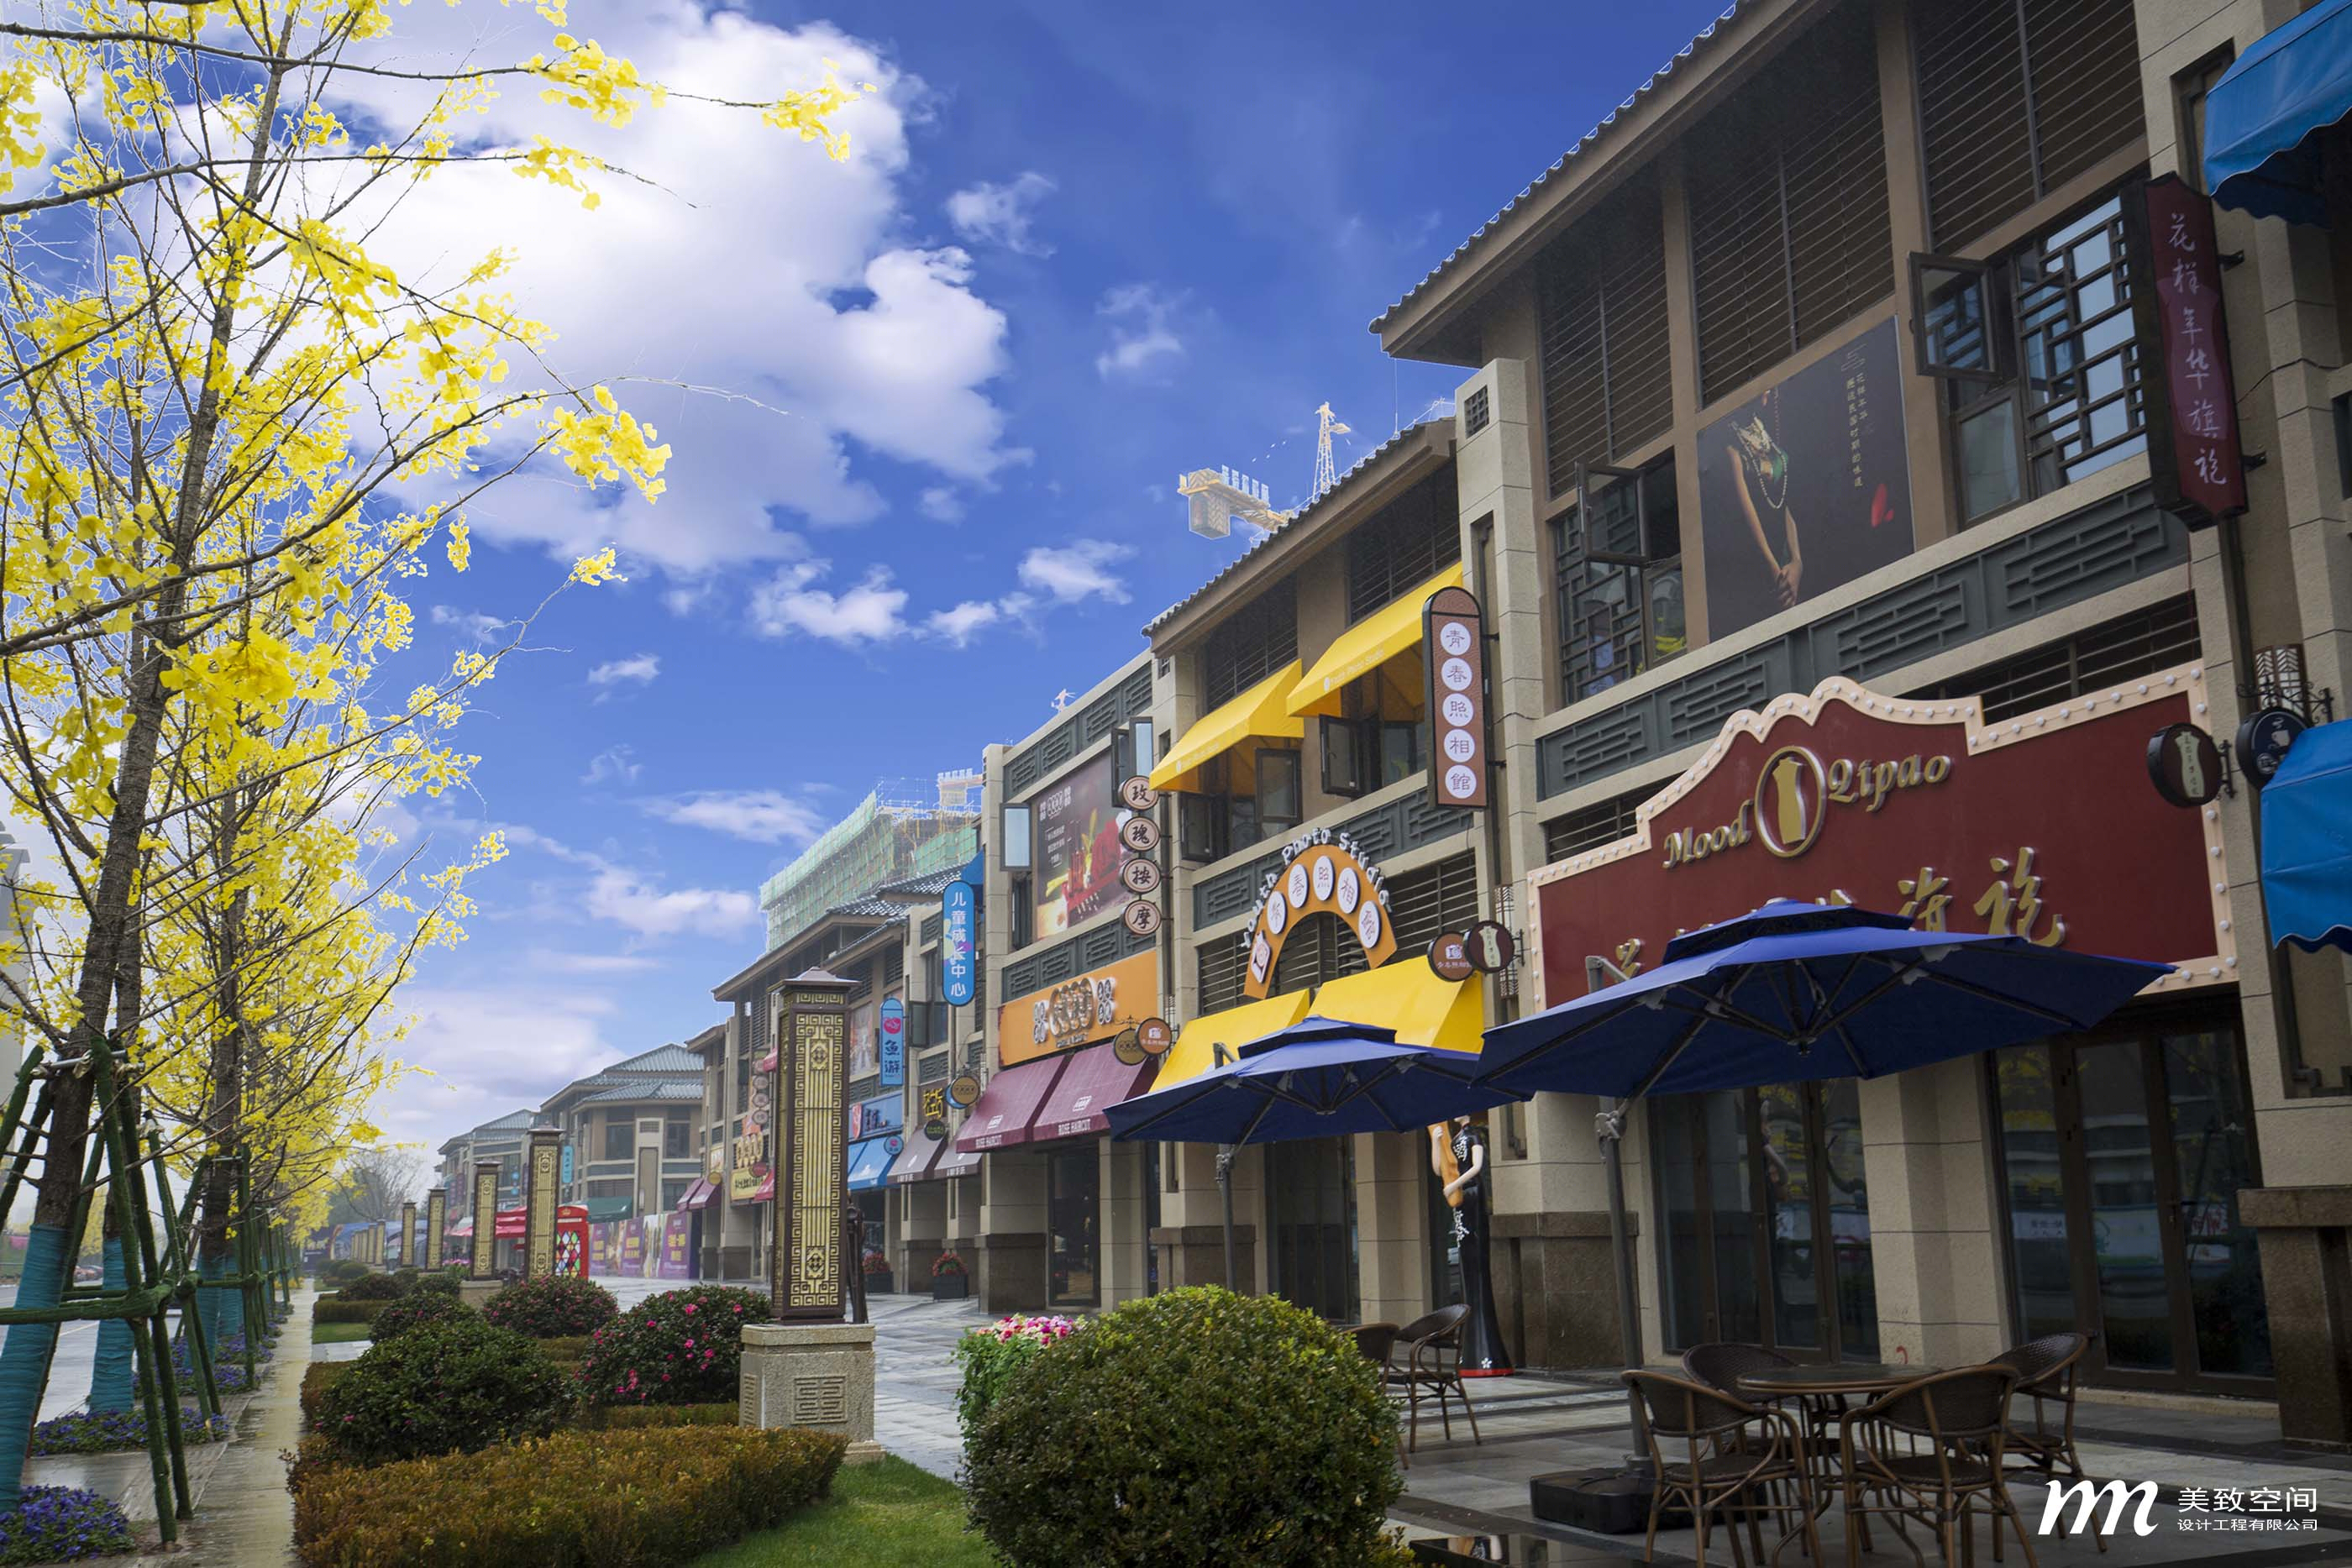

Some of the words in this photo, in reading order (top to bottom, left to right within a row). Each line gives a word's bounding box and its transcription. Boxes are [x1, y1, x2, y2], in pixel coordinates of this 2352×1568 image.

[1662, 800, 1754, 868] Mood
[1827, 754, 1951, 812] Qipao
[951, 892, 967, 997] 儿童成长中心
